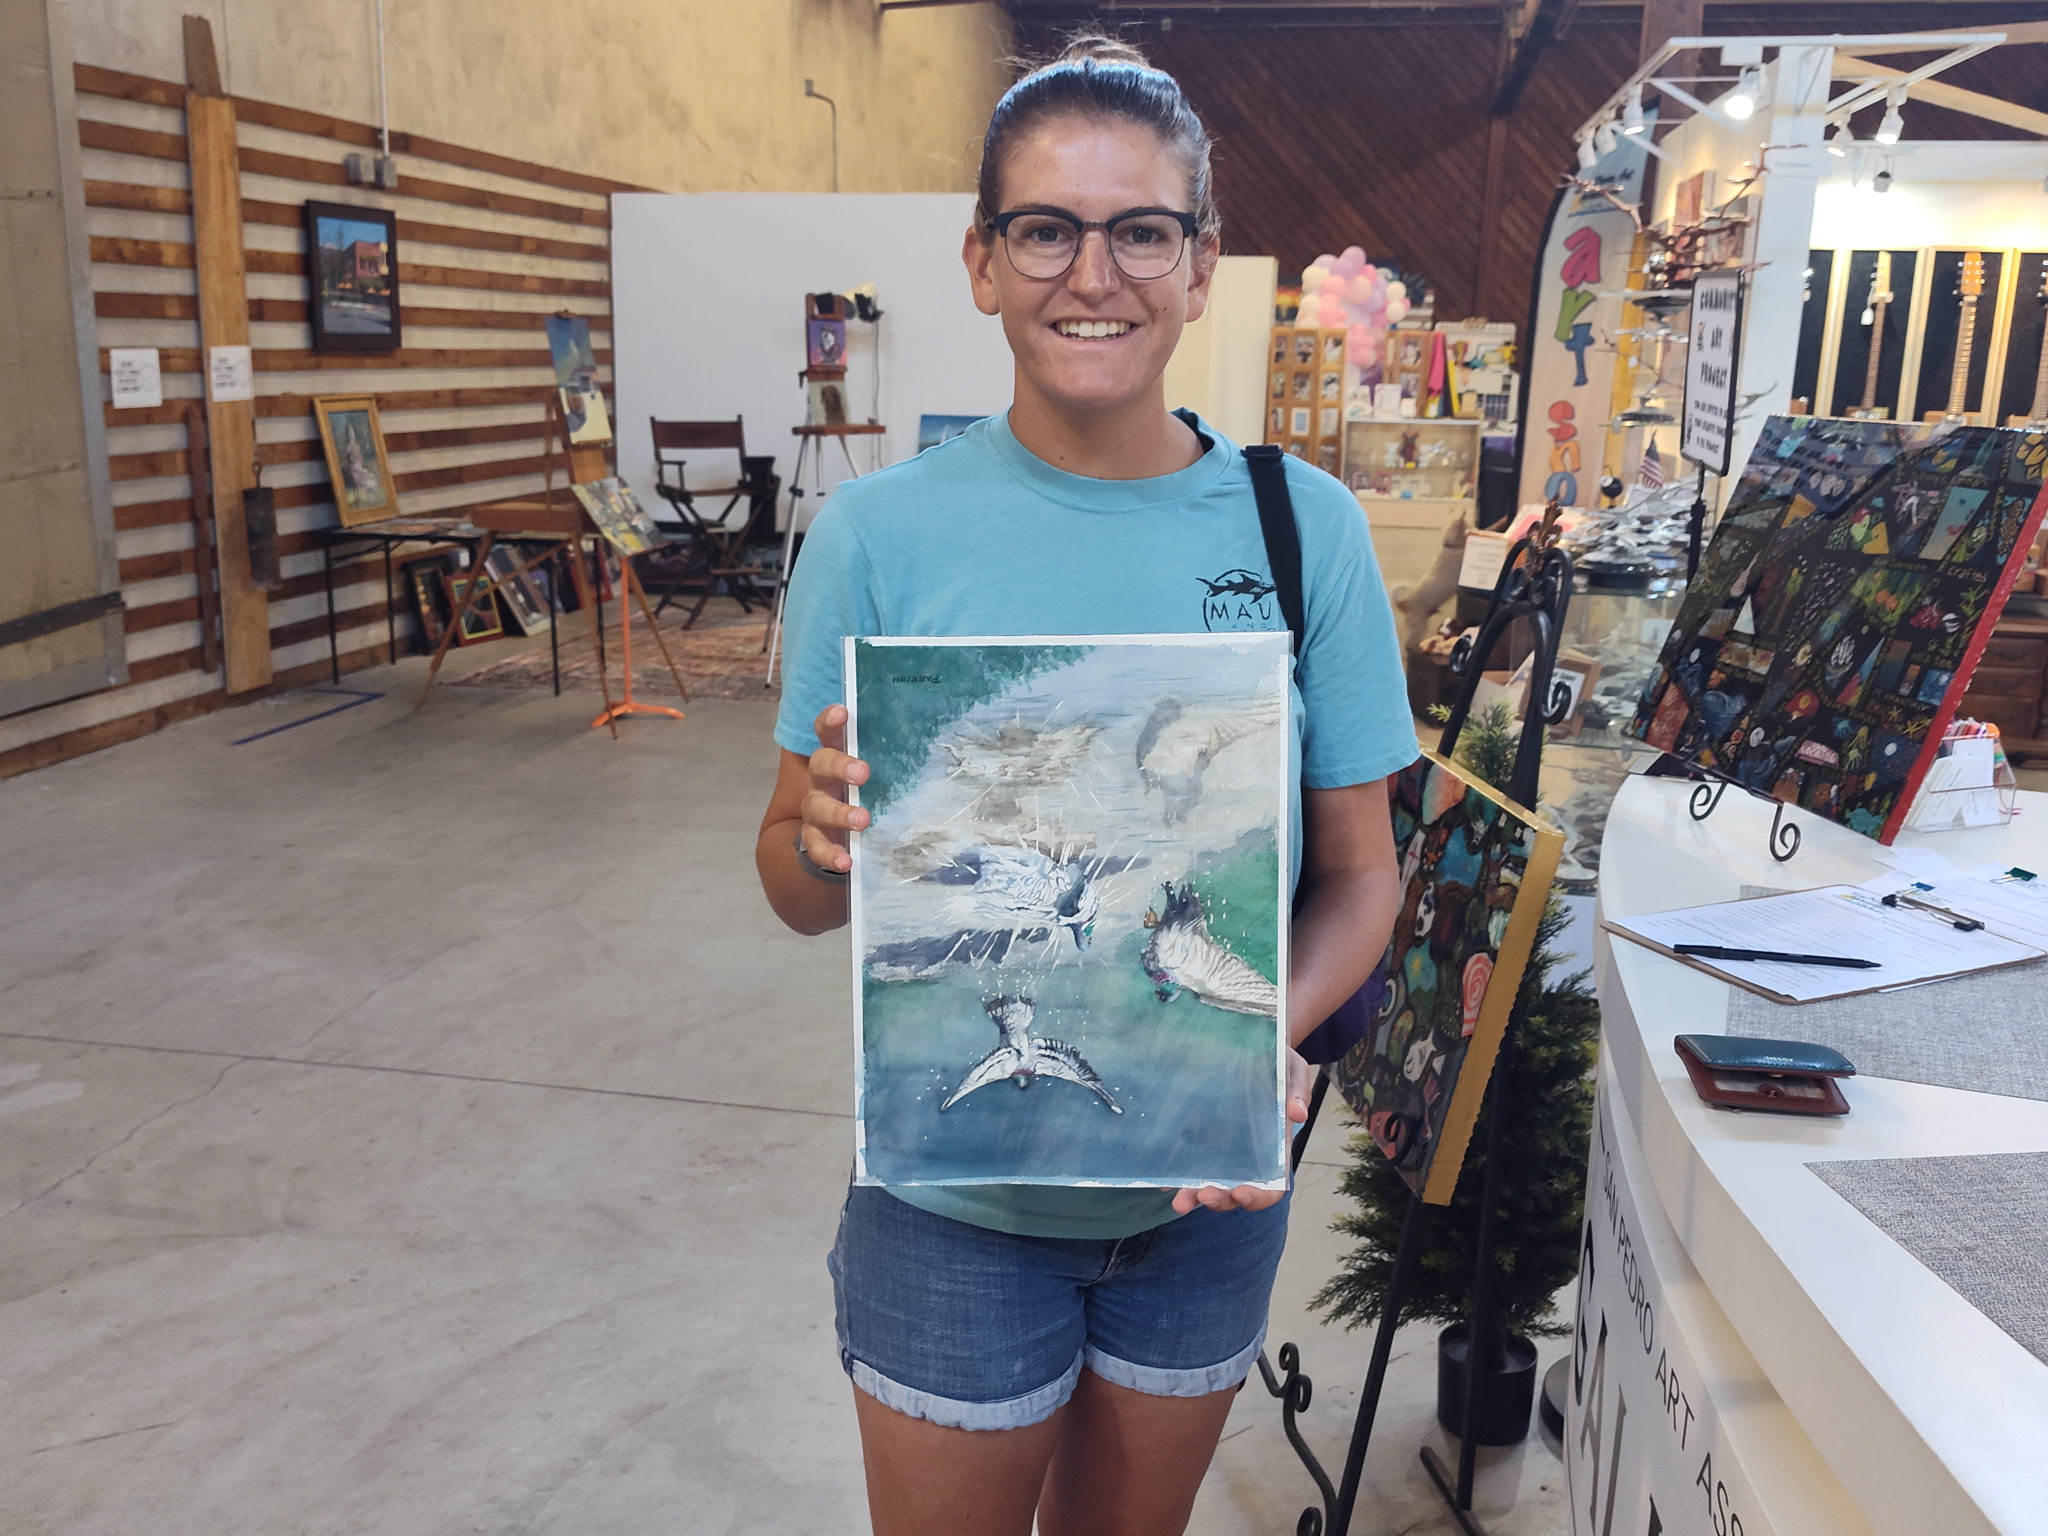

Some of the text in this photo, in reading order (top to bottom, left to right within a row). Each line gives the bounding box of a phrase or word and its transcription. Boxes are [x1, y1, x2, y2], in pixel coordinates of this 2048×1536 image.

[1554, 226, 1602, 387] art
[1701, 361, 1728, 389] PROJECT
[1210, 600, 1272, 621] MAU
[1231, 622, 1267, 630] AND
[1602, 1150, 1619, 1236] SAN
[1617, 1214, 1654, 1355] PEDRO
[1655, 1347, 1695, 1452] ART
